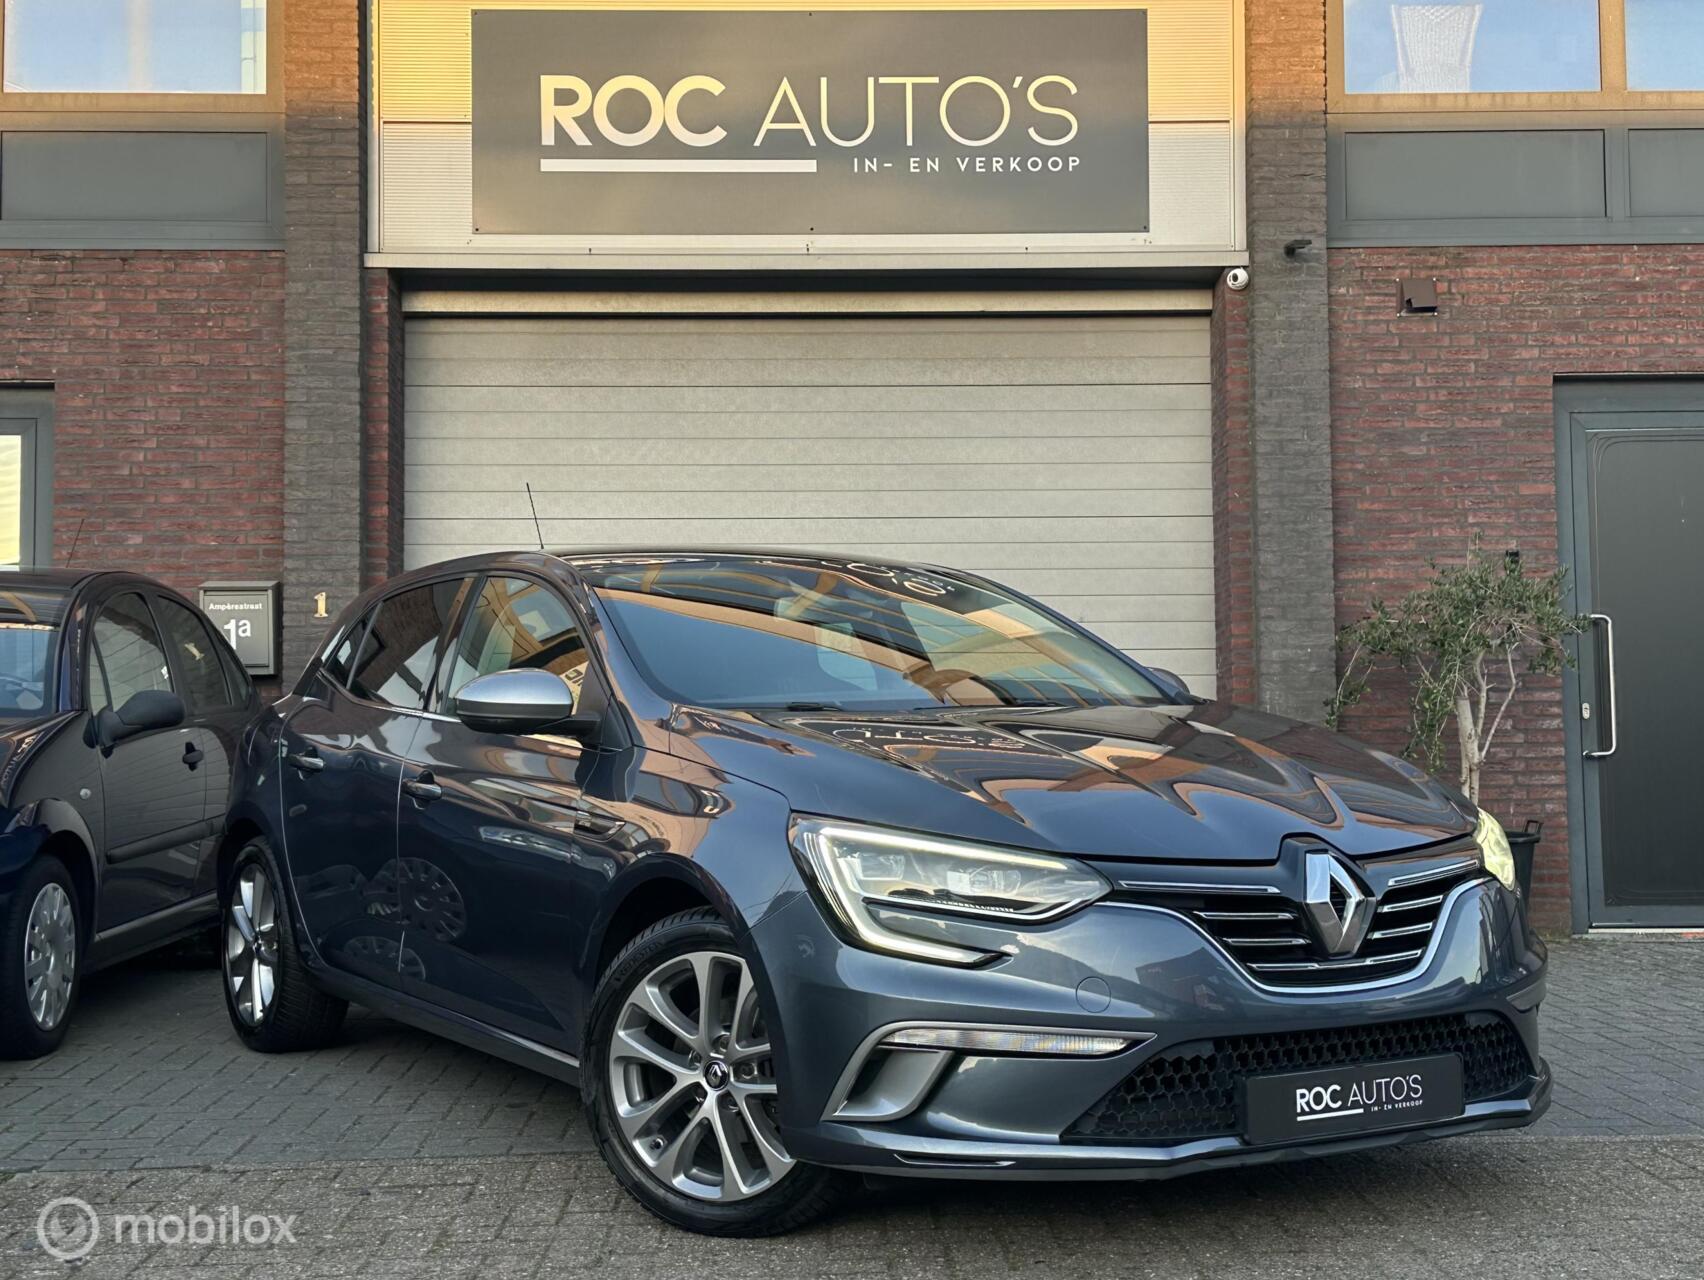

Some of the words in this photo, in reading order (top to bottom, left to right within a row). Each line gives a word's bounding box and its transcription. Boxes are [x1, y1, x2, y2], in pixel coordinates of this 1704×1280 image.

[540, 75, 728, 147] ROC
[754, 75, 1079, 147] AUTO'S
[854, 157, 893, 173] IN-
[910, 157, 940, 173] EN
[956, 157, 1080, 173] VERKOOP
[313, 592, 328, 617] 1
[223, 619, 251, 650] 1a
[1296, 1084, 1342, 1113] ROC
[1348, 1074, 1423, 1107] AUTO'S
[1395, 1099, 1424, 1109] VERKOOP
